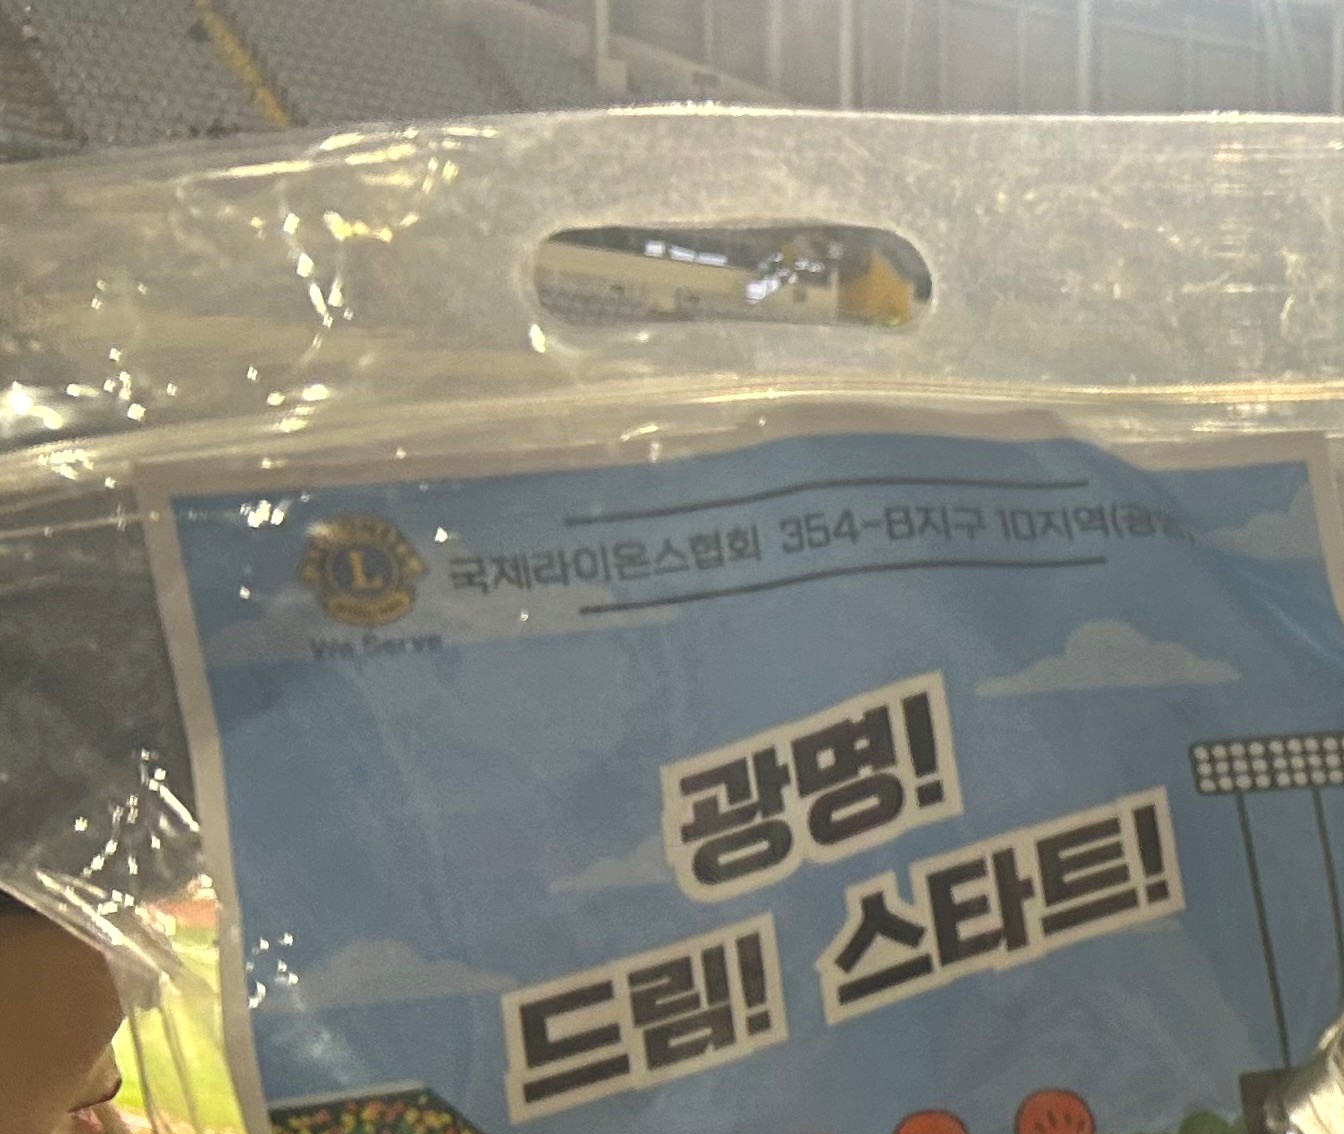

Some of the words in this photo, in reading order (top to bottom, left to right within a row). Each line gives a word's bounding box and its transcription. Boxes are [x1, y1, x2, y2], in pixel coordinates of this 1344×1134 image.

[450, 525, 762, 594] 국제라이온스협회
[680, 691, 944, 886] 광명!
[520, 931, 772, 1107] 드림!
[834, 803, 1169, 1005] 스타트!
